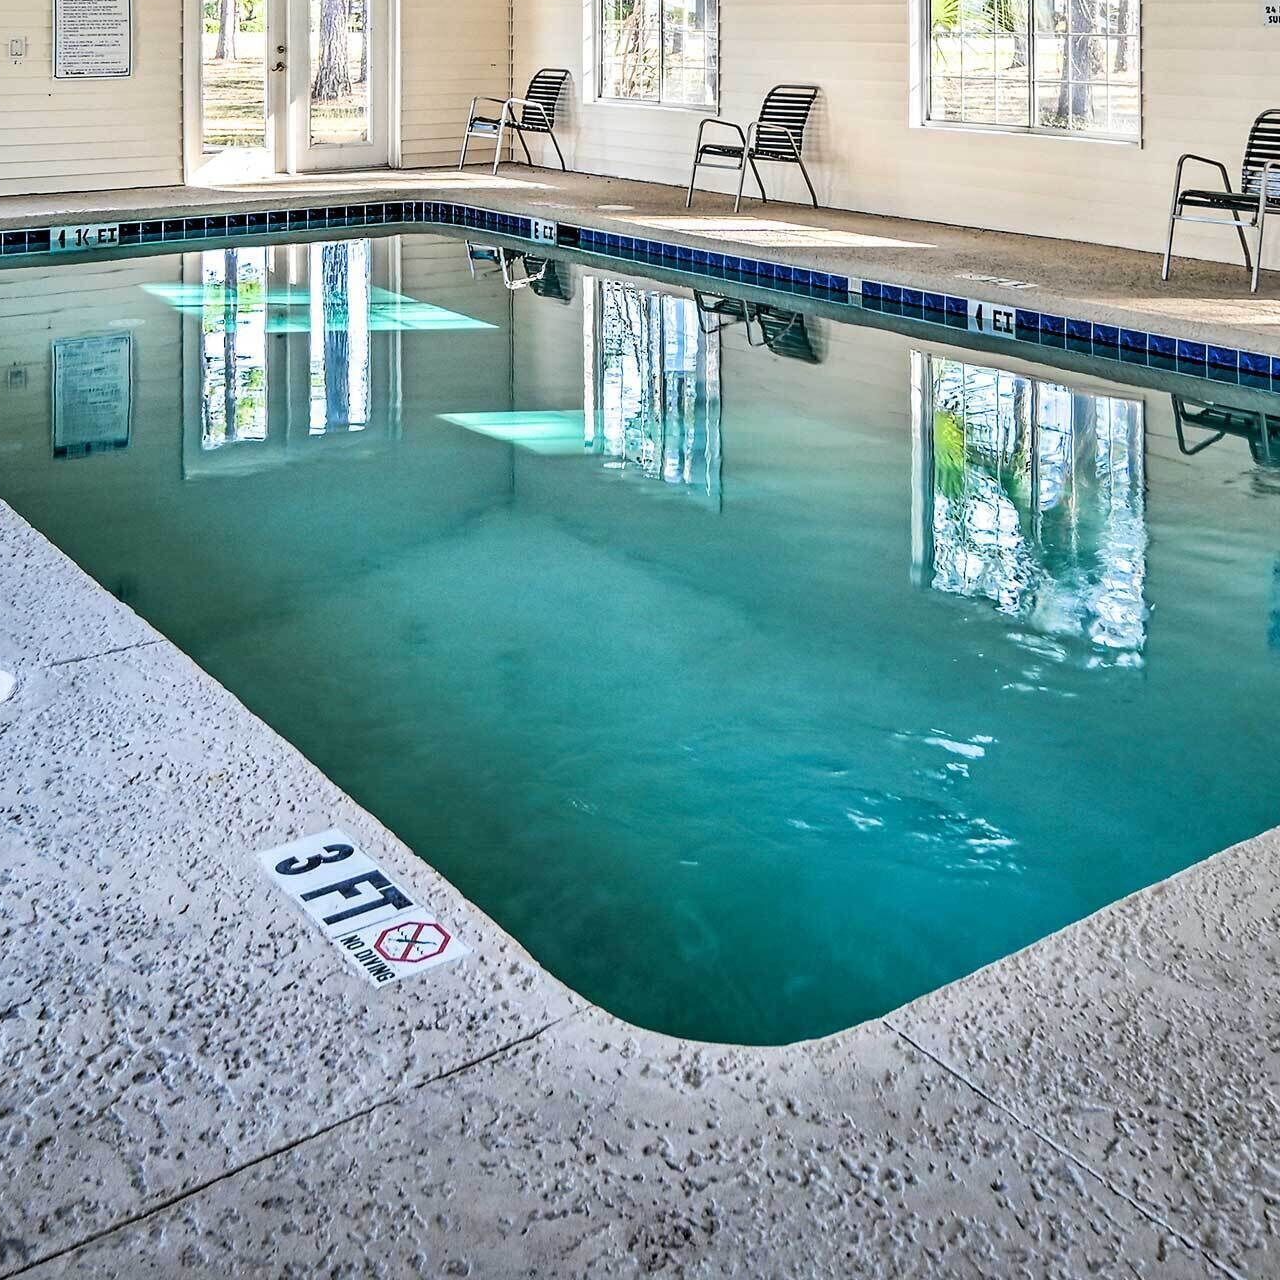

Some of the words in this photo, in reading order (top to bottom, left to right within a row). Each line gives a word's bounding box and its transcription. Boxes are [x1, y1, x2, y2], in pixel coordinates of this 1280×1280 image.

[1265, 6, 1276, 14] 24
[274, 843, 355, 876] 3
[299, 869, 415, 926] FT
[340, 934, 365, 950] NO
[353, 948, 396, 983] DIVING
